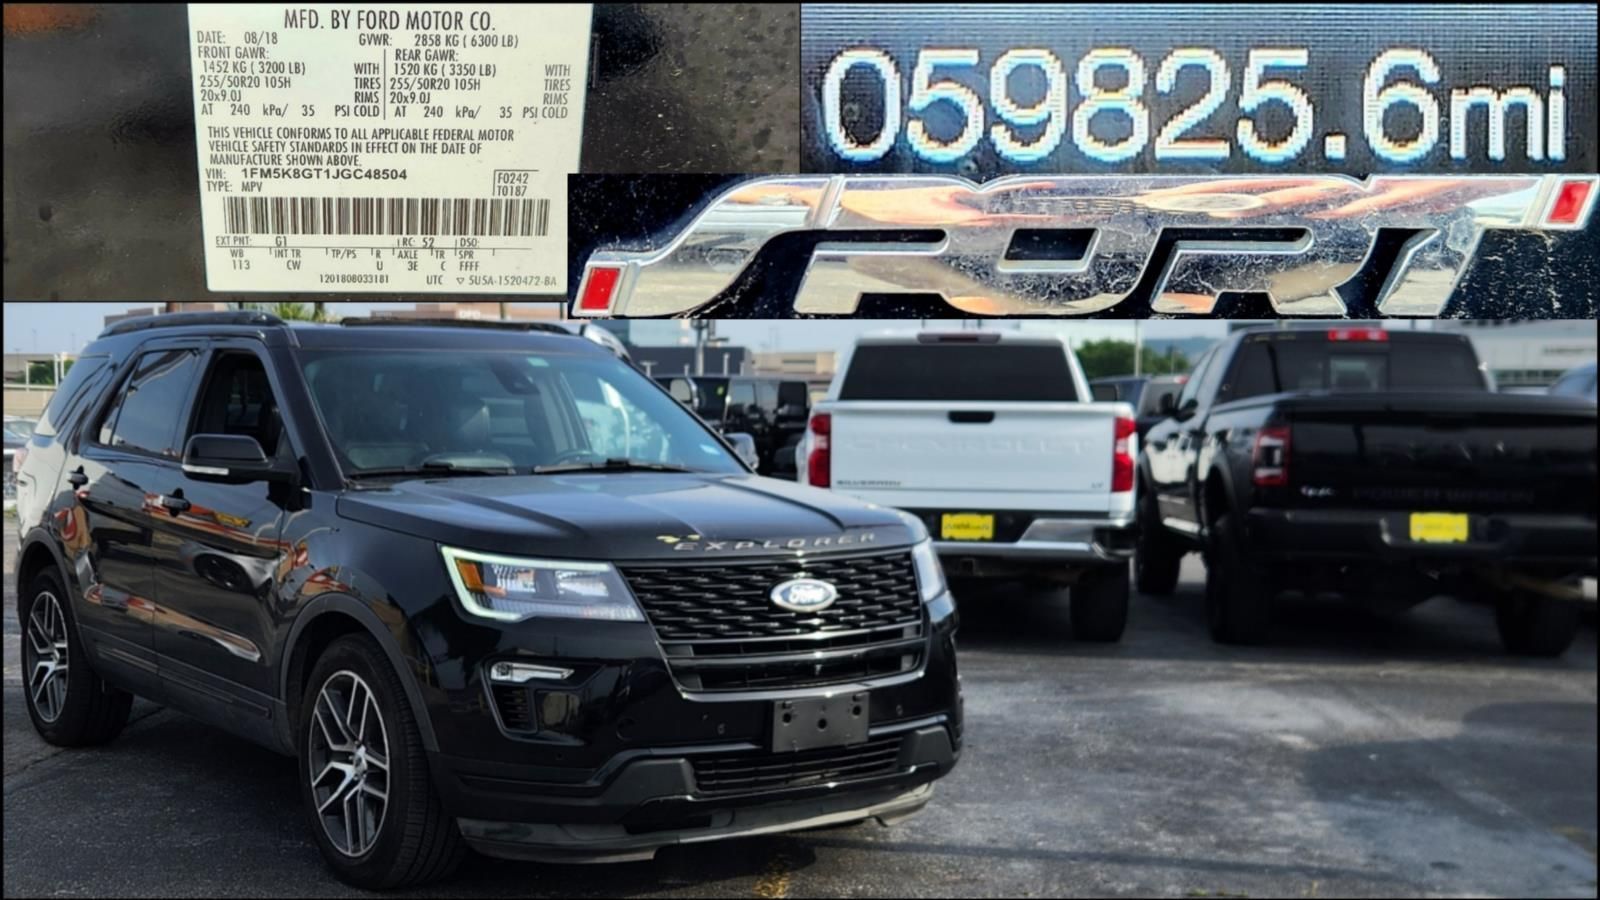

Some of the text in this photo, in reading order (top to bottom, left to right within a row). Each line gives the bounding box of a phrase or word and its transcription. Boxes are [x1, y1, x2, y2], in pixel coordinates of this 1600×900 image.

[284, 9, 496, 31] MFD. BY FORD MOTOR CO.
[197, 30, 278, 46] DATE: 08/18
[359, 33, 392, 46] GVWR:
[414, 34, 441, 47] 2858
[445, 34, 459, 47] KG
[471, 35, 499, 48] 6300
[501, 35, 519, 49] LB)
[198, 46, 270, 60] FRONT GAWR:
[395, 48, 459, 62] REAR GAWR:
[203, 61, 229, 74] 1452
[233, 61, 247, 74] KG
[258, 62, 286, 74] 3200
[289, 62, 306, 76] LB)
[354, 63, 380, 76] WITH
[395, 63, 420, 76] 1520
[424, 64, 438, 76] KG
[450, 64, 476, 76] 3350
[479, 64, 497, 78] LB)
[545, 64, 571, 77] WITH
[200, 75, 381, 90] 255/50R20 105H TIRES
[390, 77, 571, 92] 255/50R20 105H TIRES
[200, 89, 380, 104] 20x9.0J RIMS
[390, 92, 568, 105] 20x9.0J RIMS
[201, 103, 380, 118] AT 240 kPa/ 35 PSI COLD
[394, 105, 568, 119] AT 240 kPa/ 35 PSI COLD
[208, 126, 514, 141] THIS VEHICLE CONFORMS TO ALL APPLICABLE FEDERAL MOTOR
[209, 140, 482, 154] VEHICLE SAFETY STANDARDS IN EFFECT ON THE DATE OF
[210, 154, 362, 167] MANUFACTURE SHOWN ABOVE.
[206, 168, 407, 180] VIN: 1FM5K8GT1JGC48504
[497, 172, 529, 185] F0242
[207, 180, 263, 192] TYPE: MPV
[497, 185, 527, 197] T0187
[216, 236, 287, 247] EXT PNT: G1
[422, 238, 434, 249] 52
[460, 238, 479, 248] DSO:
[572, 172, 1599, 317] SPORT
[230, 248, 244, 258] WB
[275, 249, 302, 258] INT TR
[332, 249, 357, 259] TP/PS
[375, 249, 381, 259] R
[398, 250, 418, 259] AXLE
[435, 250, 445, 260] TR
[459, 250, 474, 260] SPR
[232, 259, 250, 270] 113
[287, 260, 302, 271] CW
[376, 260, 383, 271] U
[408, 261, 418, 271] 3E
[440, 261, 446, 271] C
[459, 261, 480, 271] FFFF
[319, 274, 389, 284] 1201808033181
[427, 275, 443, 285] UTC
[674, 532, 875, 551] EXPLORER
